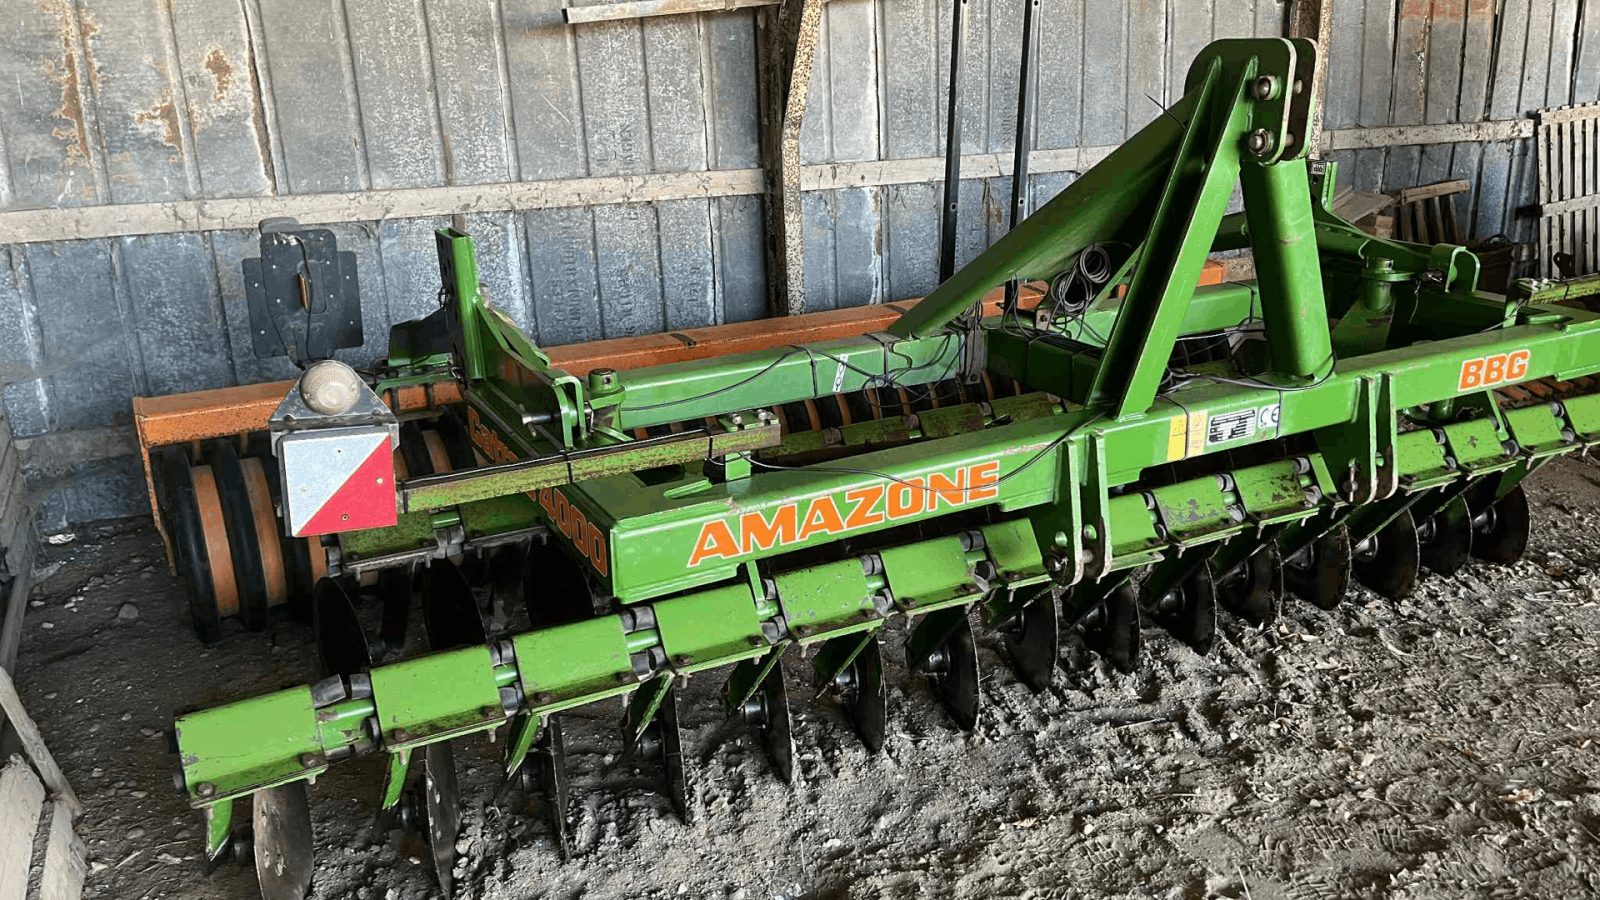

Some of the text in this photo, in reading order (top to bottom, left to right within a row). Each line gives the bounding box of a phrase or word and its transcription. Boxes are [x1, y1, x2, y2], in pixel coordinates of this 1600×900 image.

[1458, 349, 1530, 392] BBG
[539, 487, 608, 577] 4000
[687, 460, 1000, 568] AMAZONE
